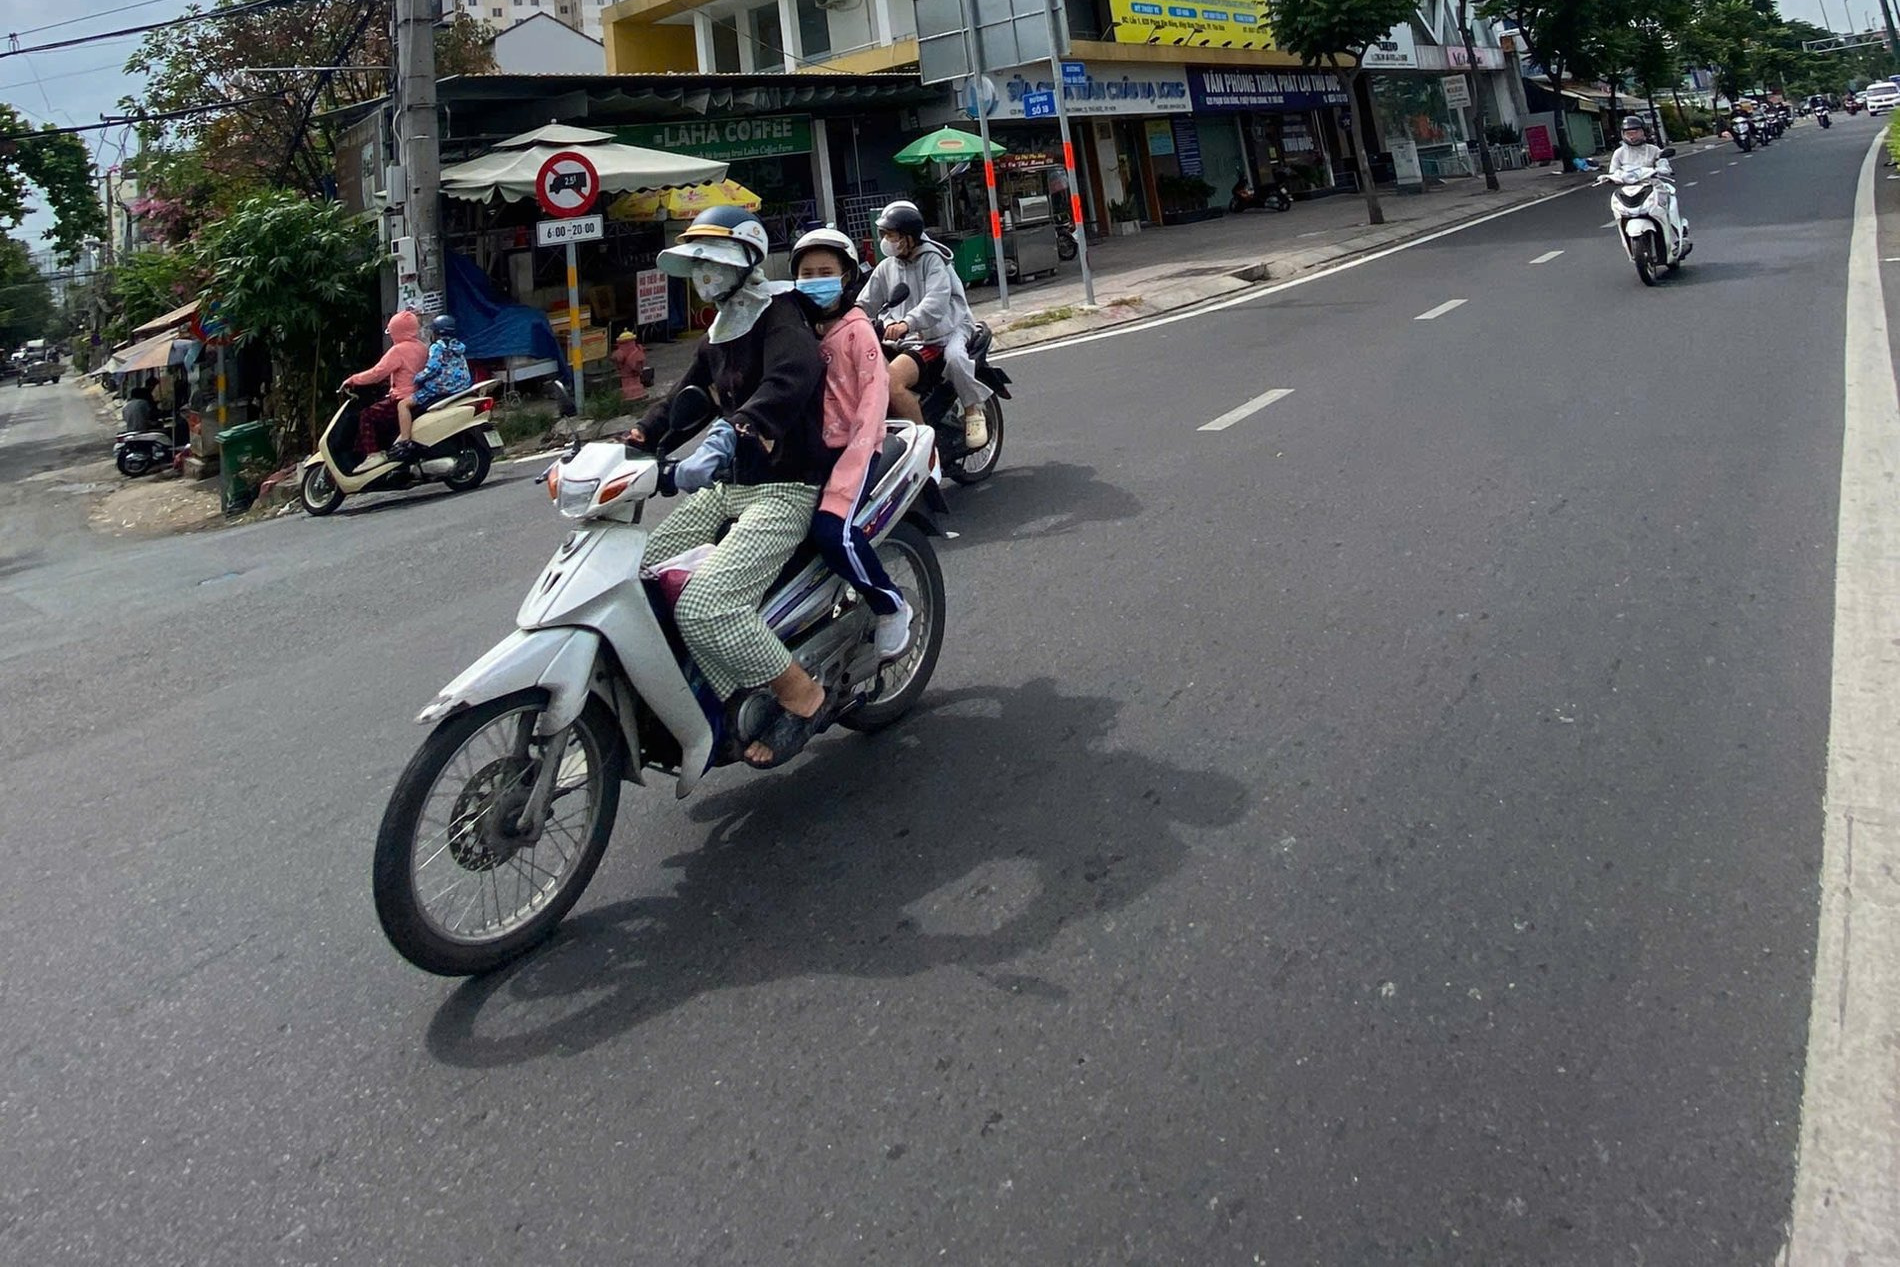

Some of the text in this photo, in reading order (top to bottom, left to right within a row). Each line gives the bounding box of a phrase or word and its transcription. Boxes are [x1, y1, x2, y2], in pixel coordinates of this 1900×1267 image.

[1202, 70, 1225, 93] VĂN
[664, 123, 720, 147] LAHA
[725, 118, 793, 143] COFFEE
